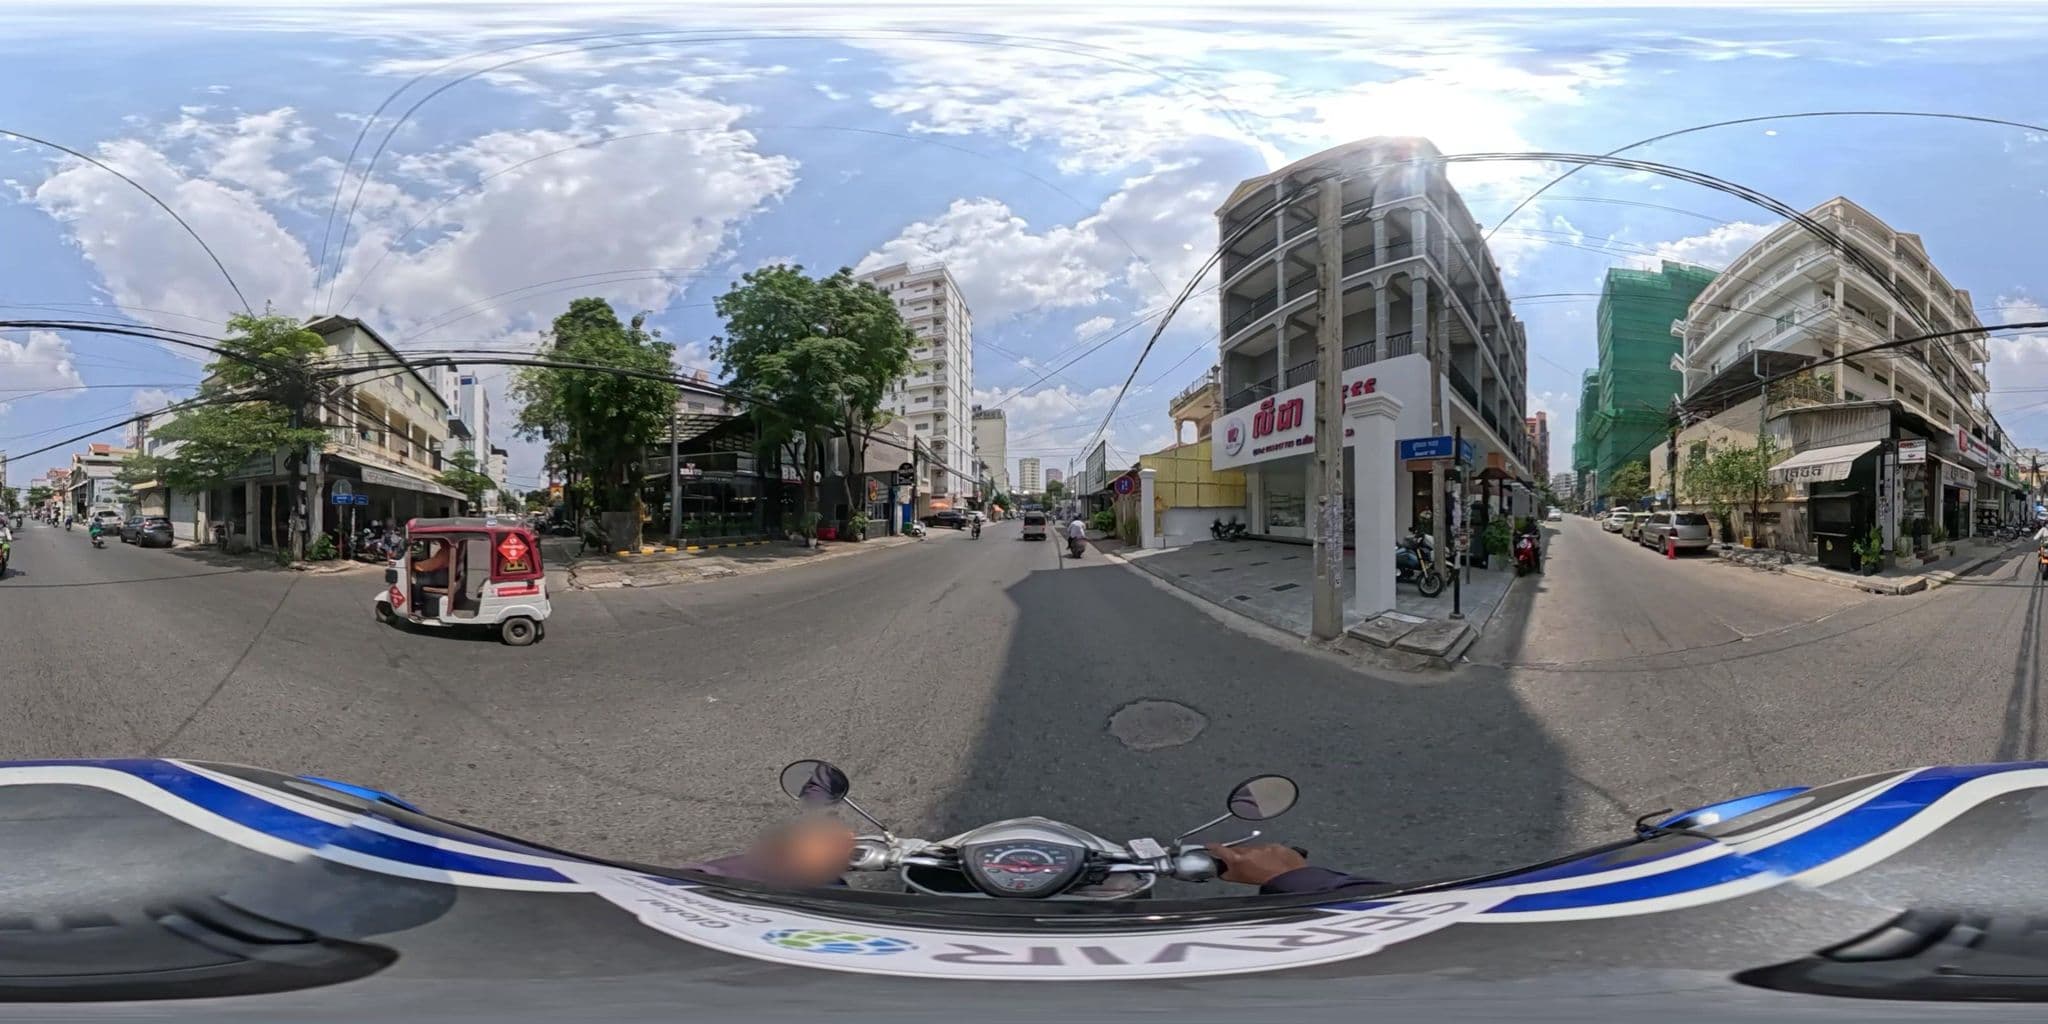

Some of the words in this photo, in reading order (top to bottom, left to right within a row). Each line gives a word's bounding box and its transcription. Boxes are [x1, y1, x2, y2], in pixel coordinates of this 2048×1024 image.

[781, 465, 822, 483] BRO
[635, 899, 730, 929] Global
[932, 902, 1468, 967] SERVIR
